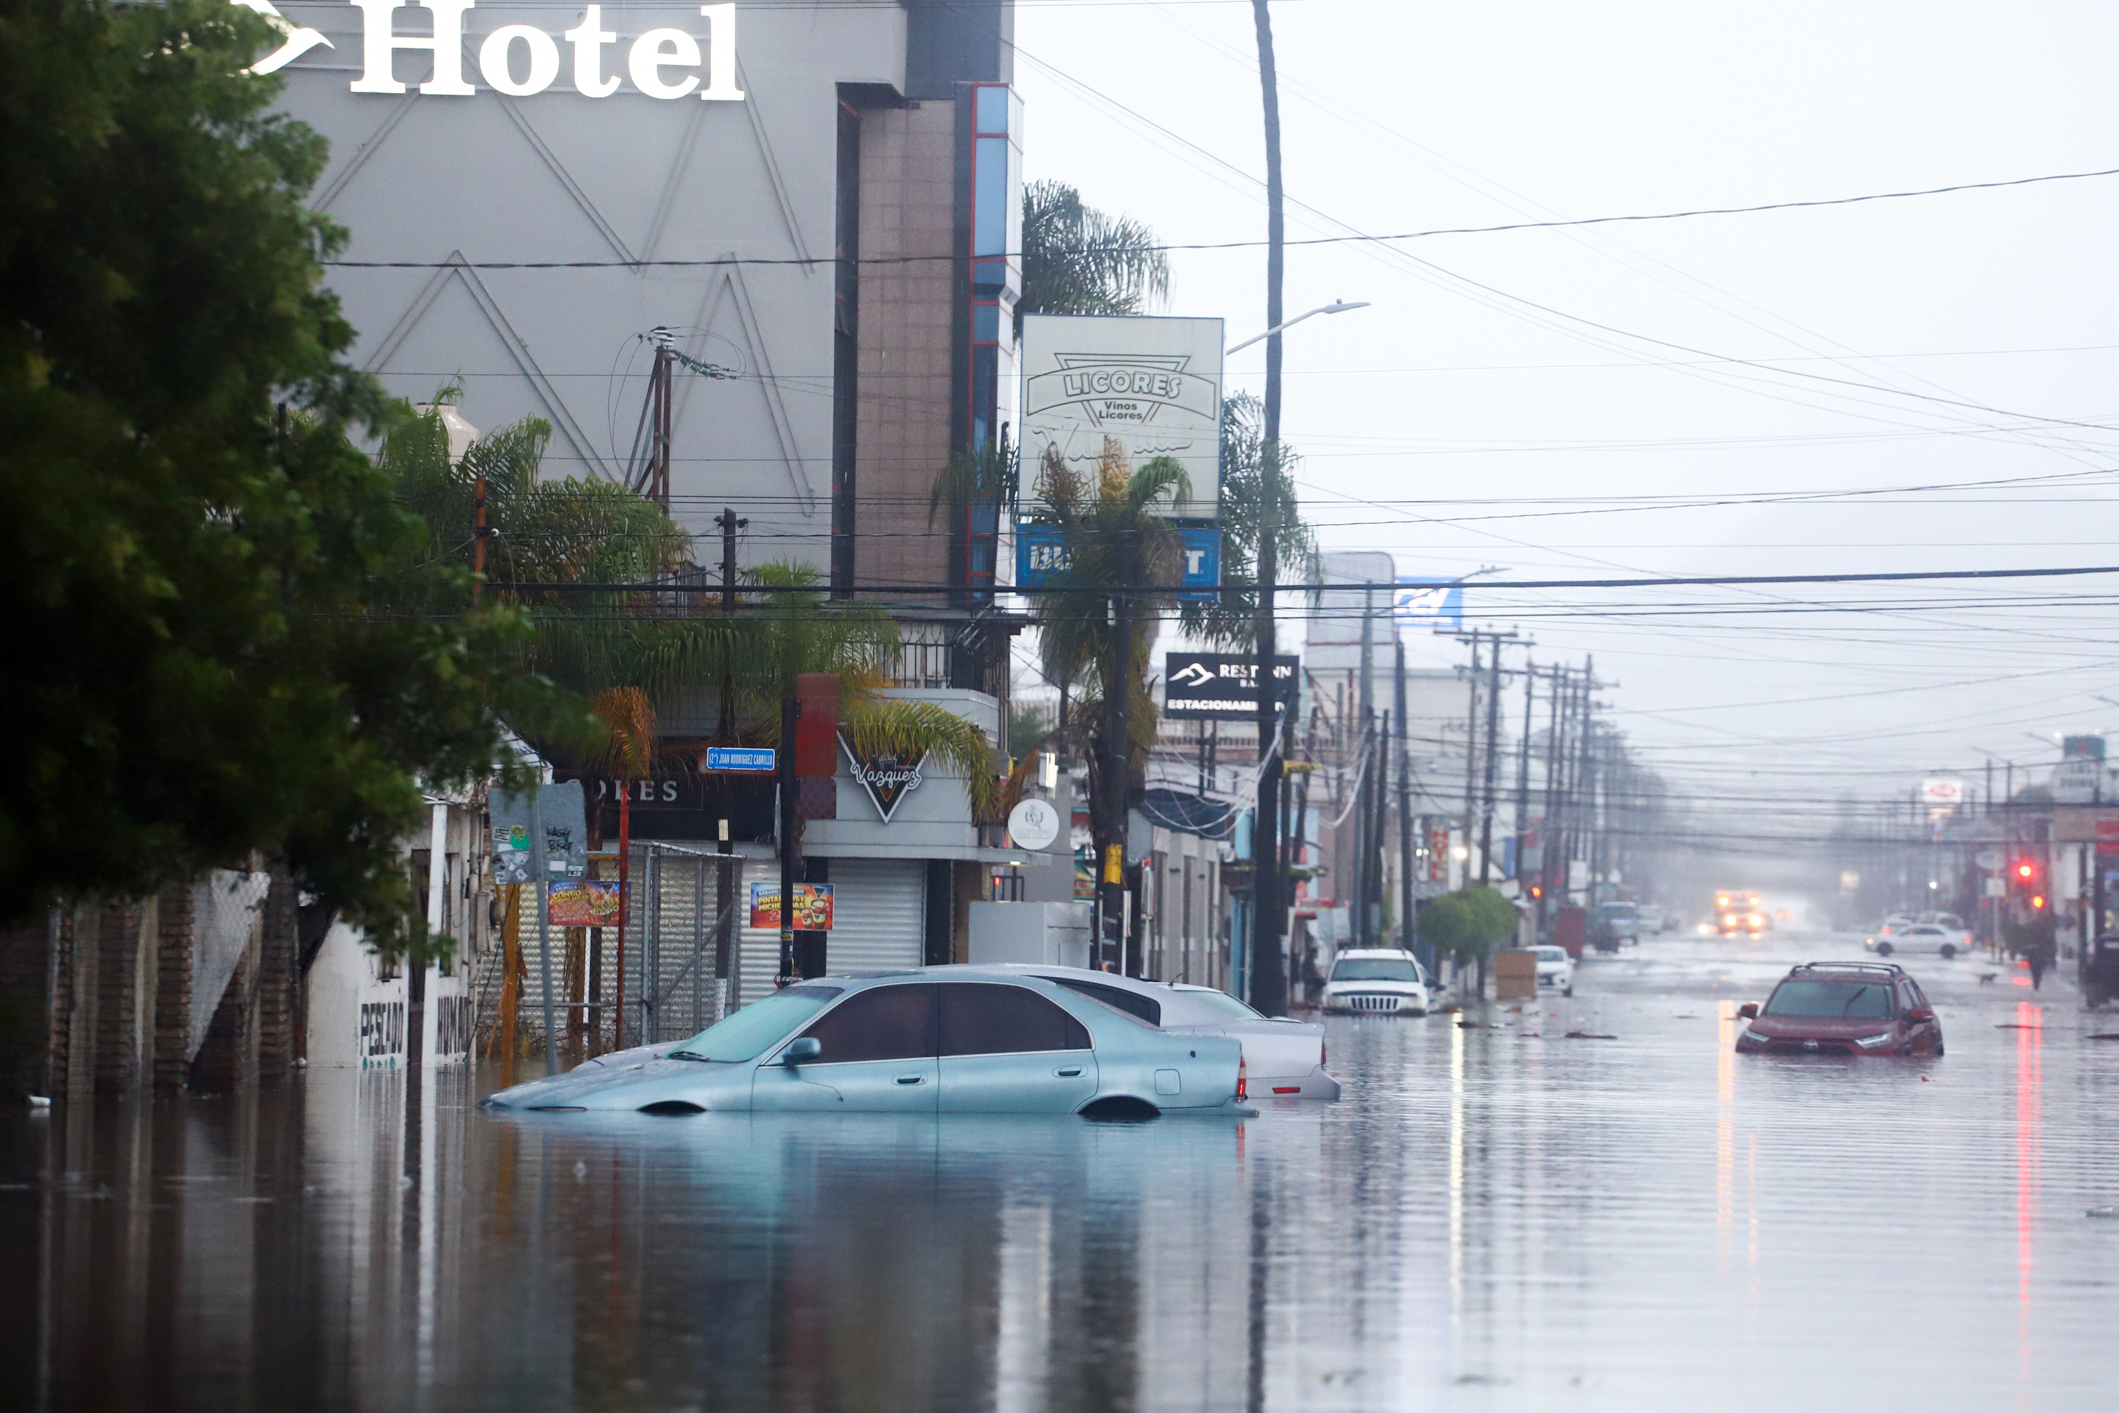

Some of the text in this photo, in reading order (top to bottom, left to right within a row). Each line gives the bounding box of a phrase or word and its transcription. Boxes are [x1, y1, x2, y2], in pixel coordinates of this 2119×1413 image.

[350, 0, 745, 101] Hotel
[1063, 370, 1182, 399] LICORES
[1099, 410, 1143, 420] Licores
[1104, 401, 1138, 411] Vinos
[719, 753, 730, 764] JUAN
[852, 762, 920, 789] Vazquez
